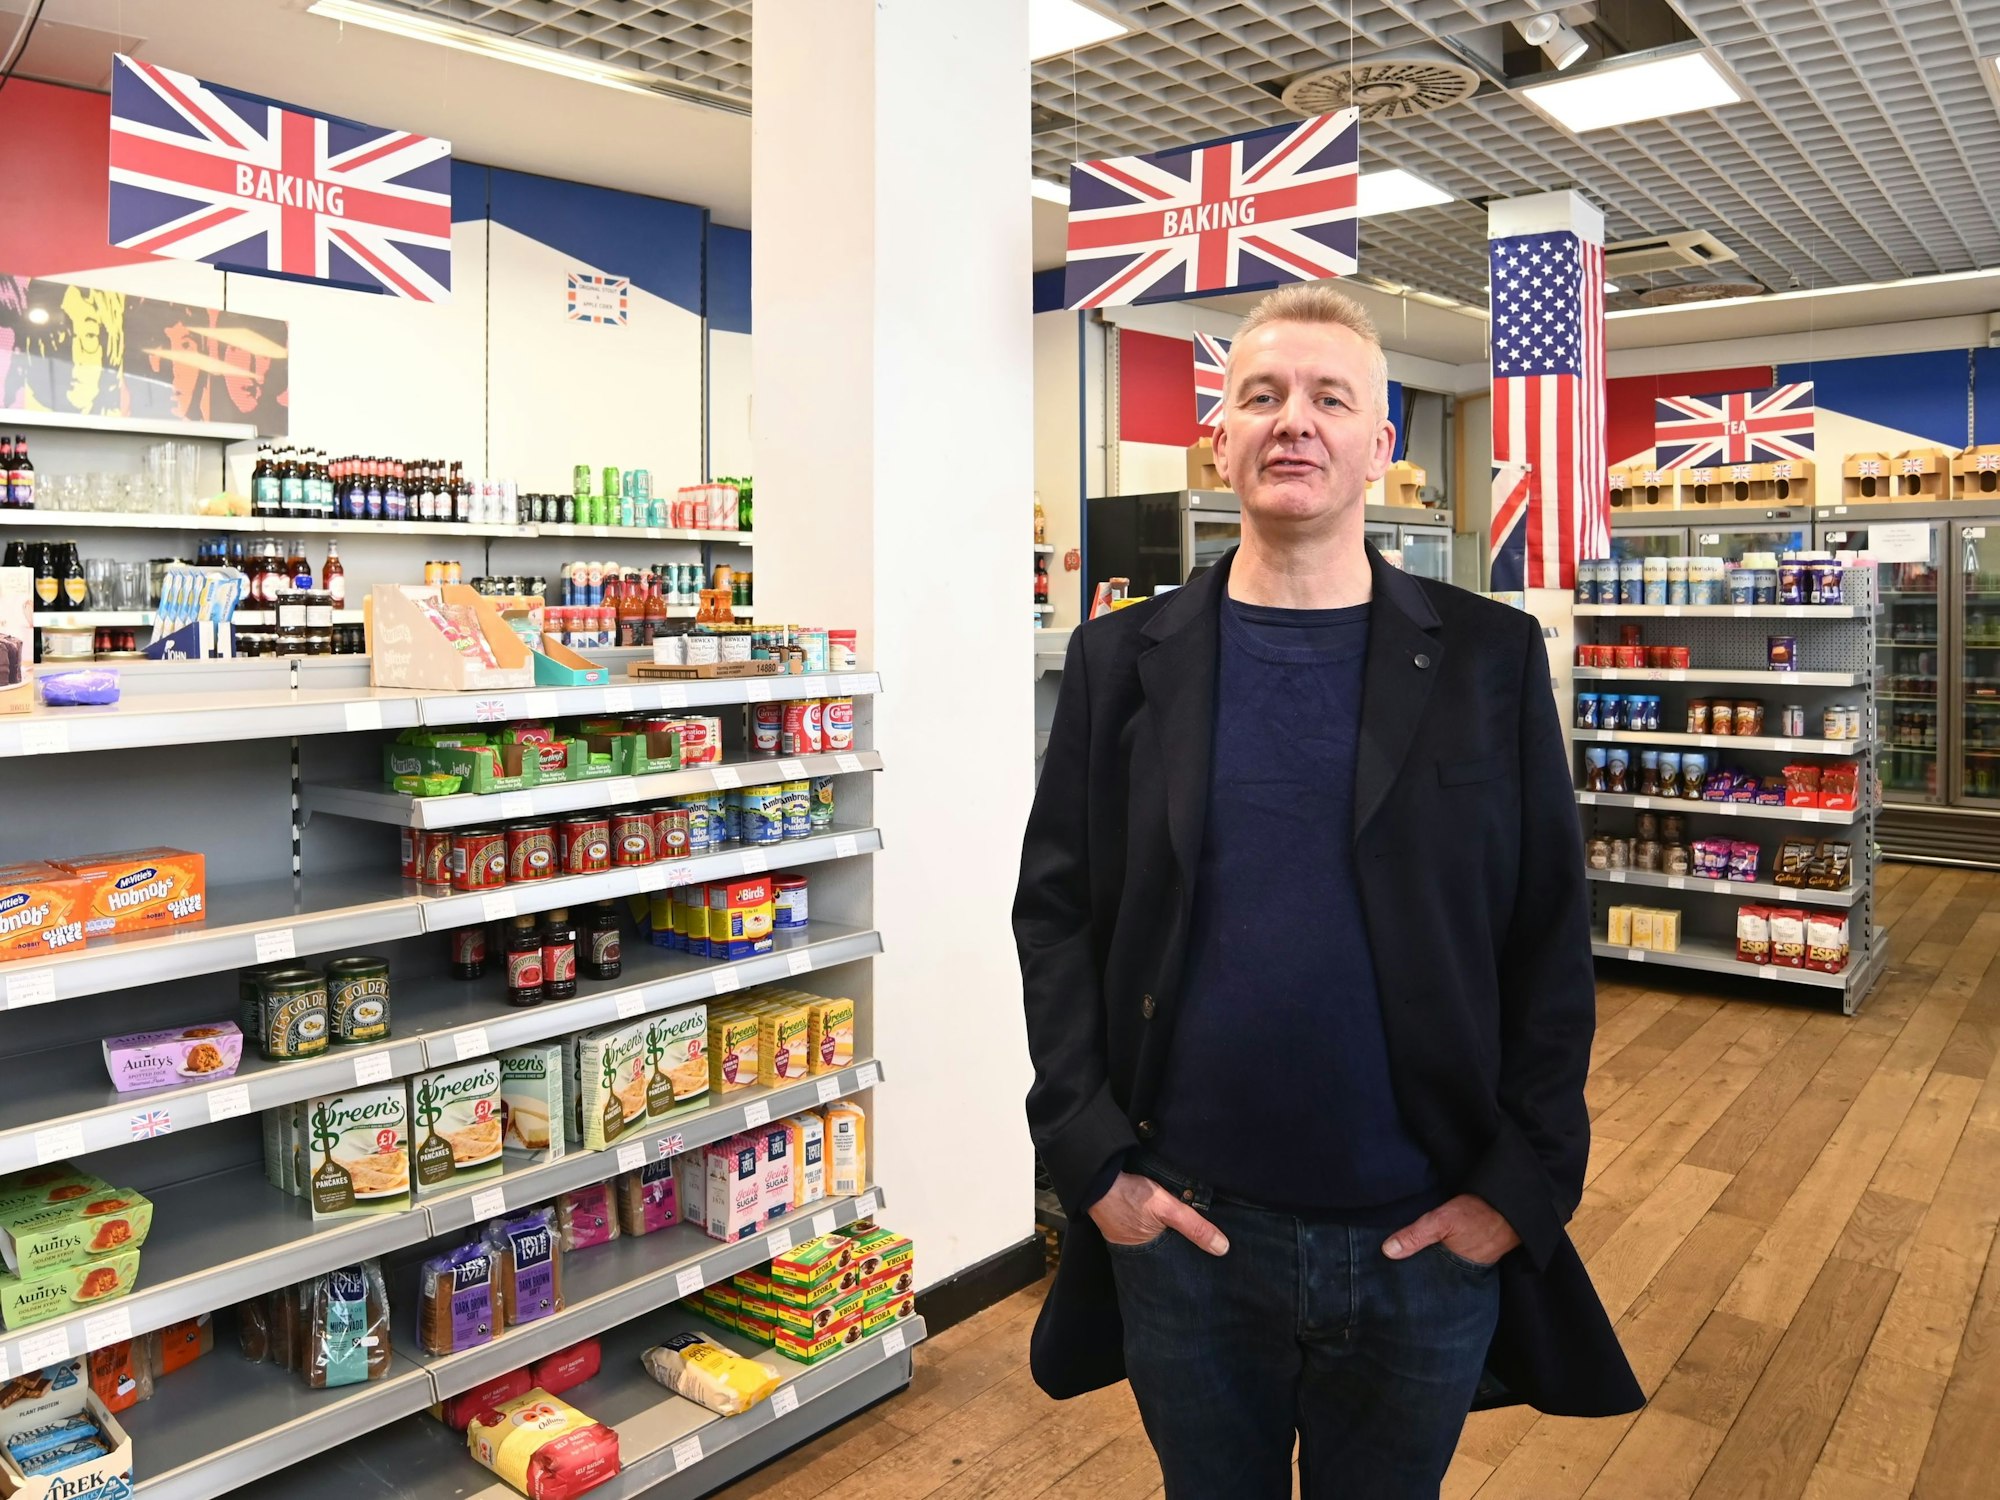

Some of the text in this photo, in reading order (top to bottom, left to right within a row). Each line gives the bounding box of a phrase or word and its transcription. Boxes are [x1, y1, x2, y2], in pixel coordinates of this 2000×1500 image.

[236, 163, 344, 216] BAKING
[1163, 196, 1255, 238] BAKING
[1722, 420, 1748, 436] TEA
[1775, 873, 1802, 883] Galaxy
[1808, 877, 1835, 886] Galaxy
[742, 886, 764, 900] Bird's
[167, 893, 202, 911] GLUTEN
[173, 901, 202, 919] FREE
[42, 921, 82, 939] GLUTEN
[49, 931, 83, 948] FREE
[345, 981, 387, 1000] GOLDEN
[645, 1012, 703, 1065] Green's
[122, 1055, 173, 1072] Aunty's
[500, 1055, 544, 1072] reen's
[602, 1029, 642, 1088] Green's
[416, 1068, 495, 1127] Green's
[648, 1083, 671, 1096] PANCAKES
[476, 1101, 490, 1117] £1
[310, 1096, 400, 1152] Green's
[379, 1131, 394, 1146] £1
[420, 1148, 450, 1162] PANCAKES
[316, 1176, 348, 1189] PANCAKES
[766, 1176, 788, 1190] SUGAR
[736, 1194, 758, 1209] SUGAR
[12, 1208, 74, 1227] Aunty's
[28, 1235, 81, 1259] Aunty's
[32, 1250, 74, 1265] GOLDEN SYRUP
[887, 1252, 909, 1267] ATORA
[815, 1261, 833, 1276] ATORA
[518, 1273, 550, 1292] DARK BROWN
[813, 1283, 833, 1298] ATORA
[866, 1282, 888, 1296] ATORA
[14, 1285, 67, 1308] Aunty's
[529, 1287, 541, 1296] SOFT
[18, 1300, 60, 1315] GOLDEN SYRUP
[455, 1296, 488, 1315] DARK BROWN
[839, 1302, 859, 1316] ATORA
[466, 1312, 479, 1320] SOFT
[869, 1310, 891, 1325] ATORA
[815, 1336, 837, 1352] ATORA
[19, 1401, 60, 1417] PLANT PROTEIN
[14, 1422, 57, 1440] TREK
[555, 1439, 569, 1450] SELF
[575, 1458, 605, 1476] SELF RAISING
[49, 1470, 104, 1500] TREK
